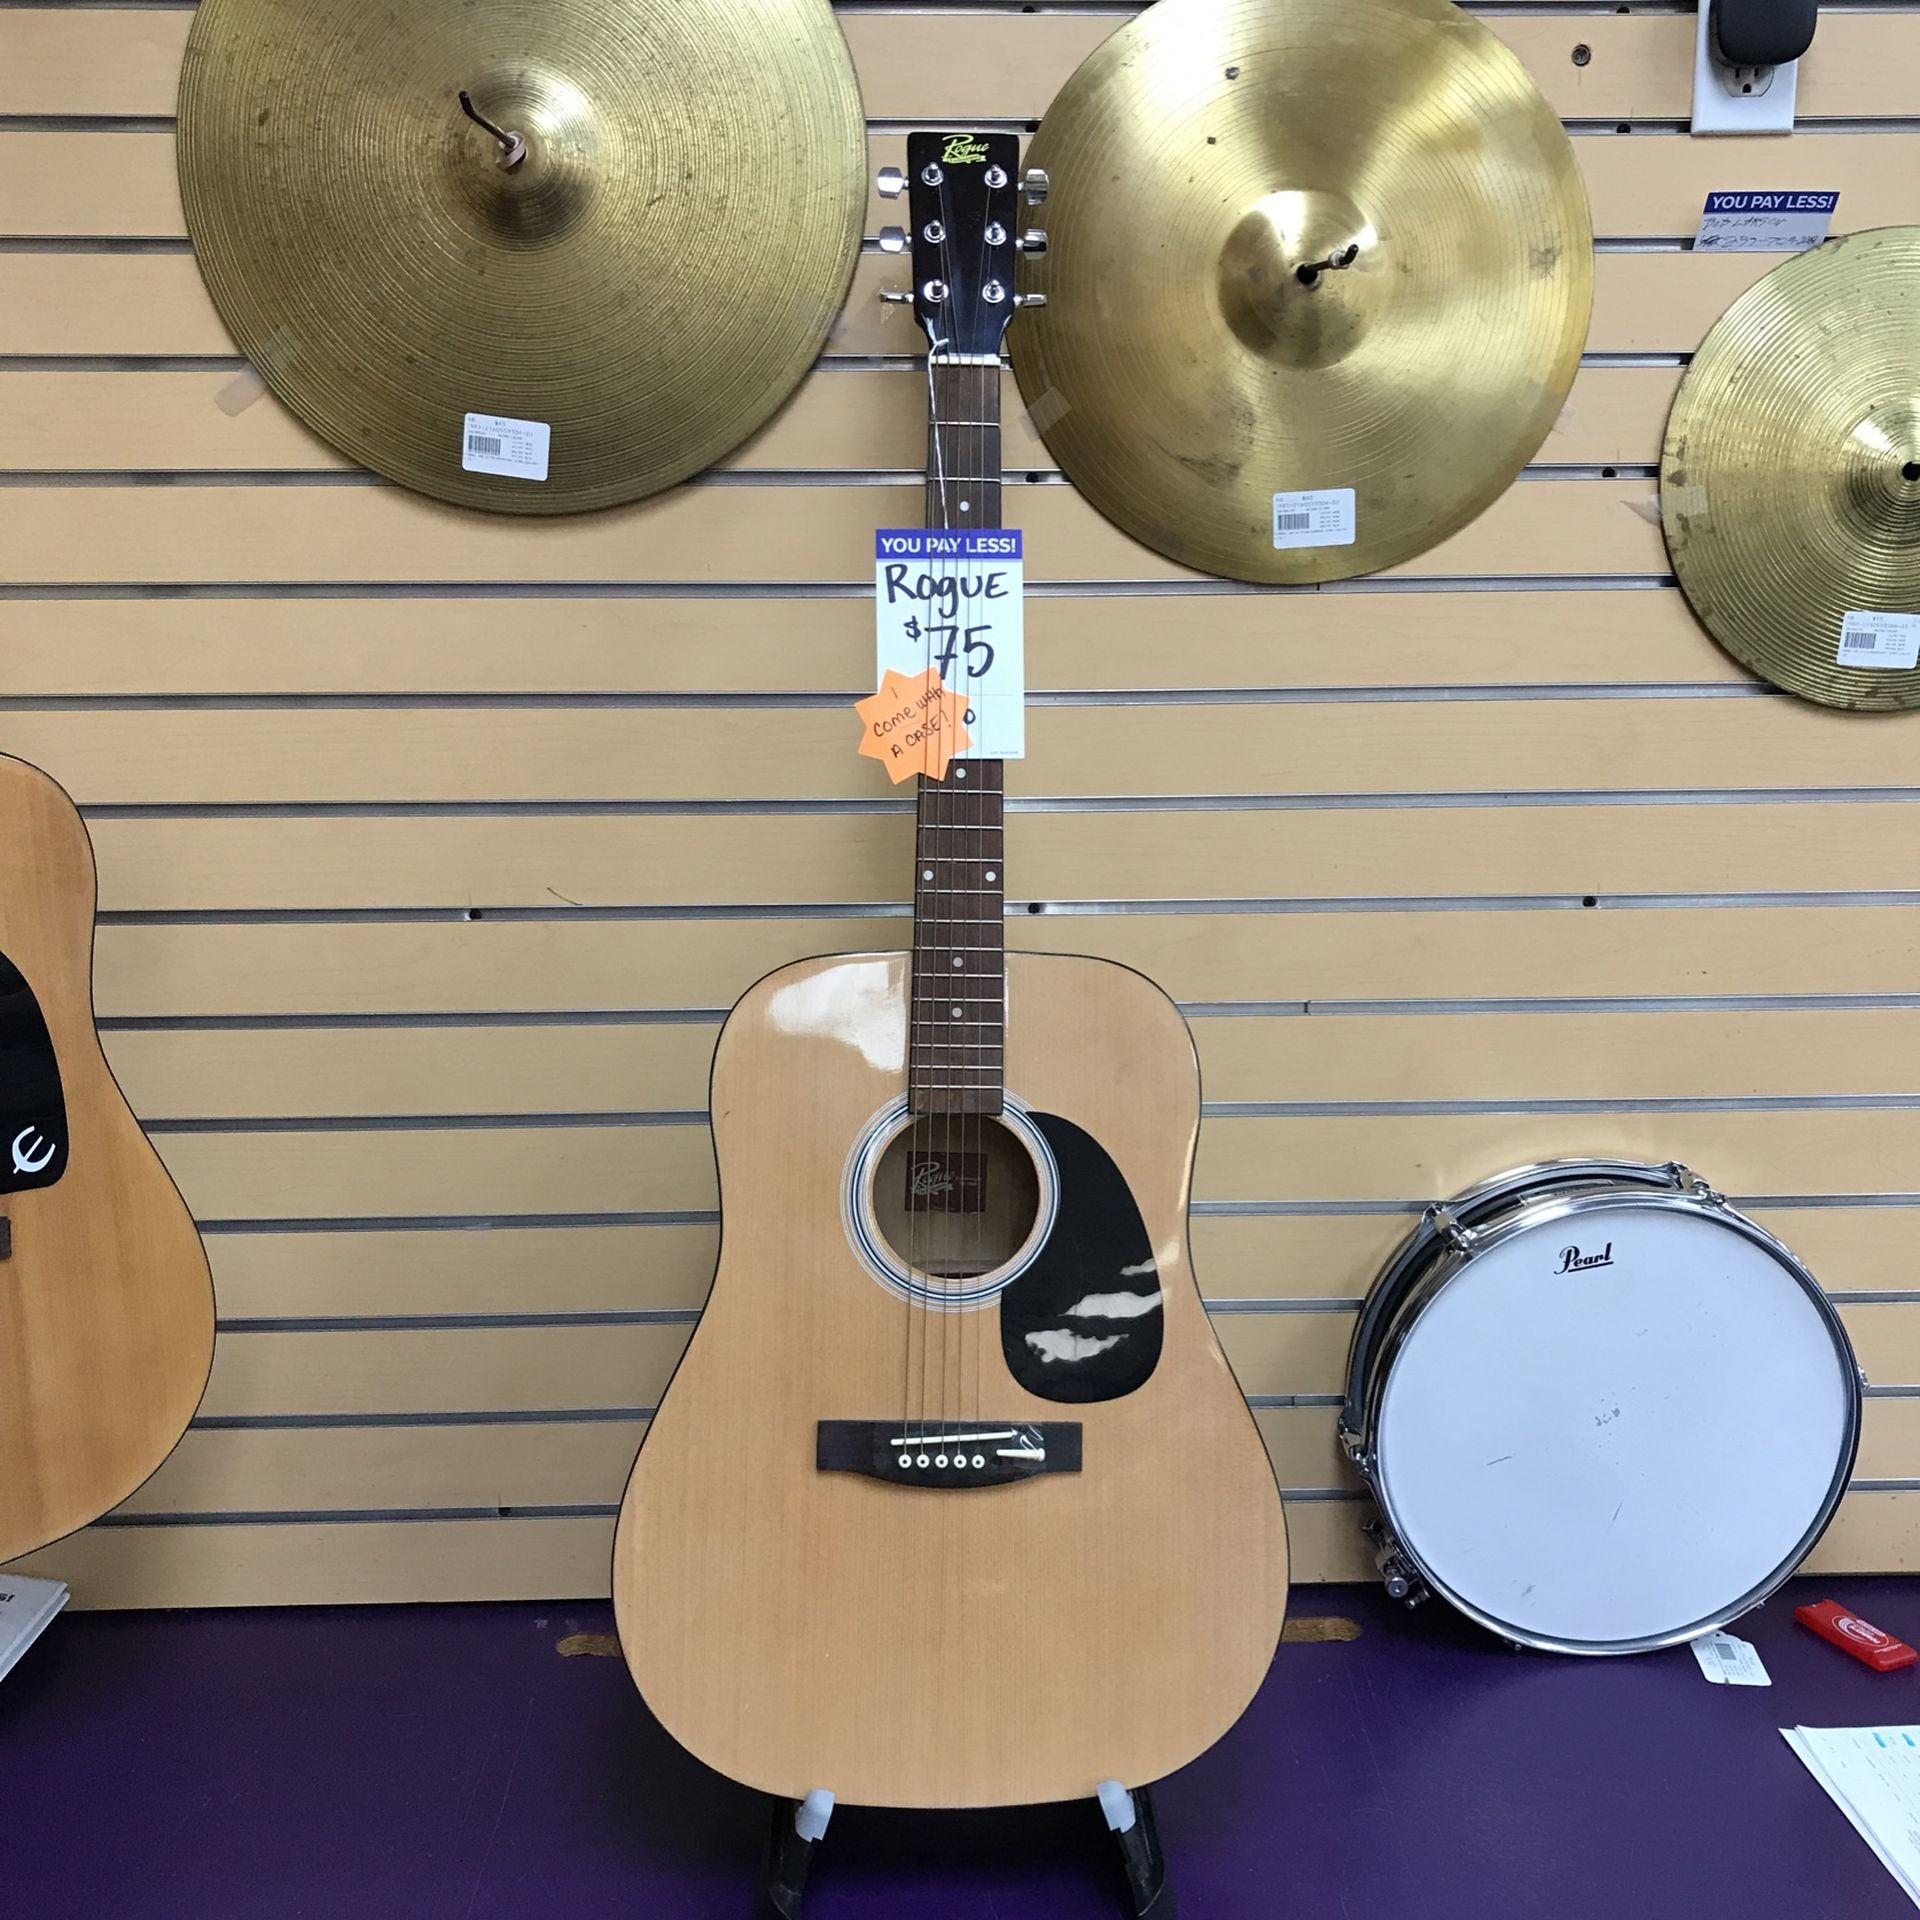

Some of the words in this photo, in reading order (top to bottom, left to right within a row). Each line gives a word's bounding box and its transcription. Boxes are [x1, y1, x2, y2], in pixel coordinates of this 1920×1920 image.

[942, 134, 990, 161] Rogue
[1713, 196, 1747, 209] YOU
[1750, 196, 1784, 208] PAY
[1786, 196, 1834, 208] LESS!
[881, 538, 921, 553] YOU
[926, 538, 961, 553] PAY
[966, 538, 1016, 553] LESS!
[904, 615, 995, 681] $75
[890, 743, 904, 758] A
[1553, 1242, 1612, 1275] Pearl
